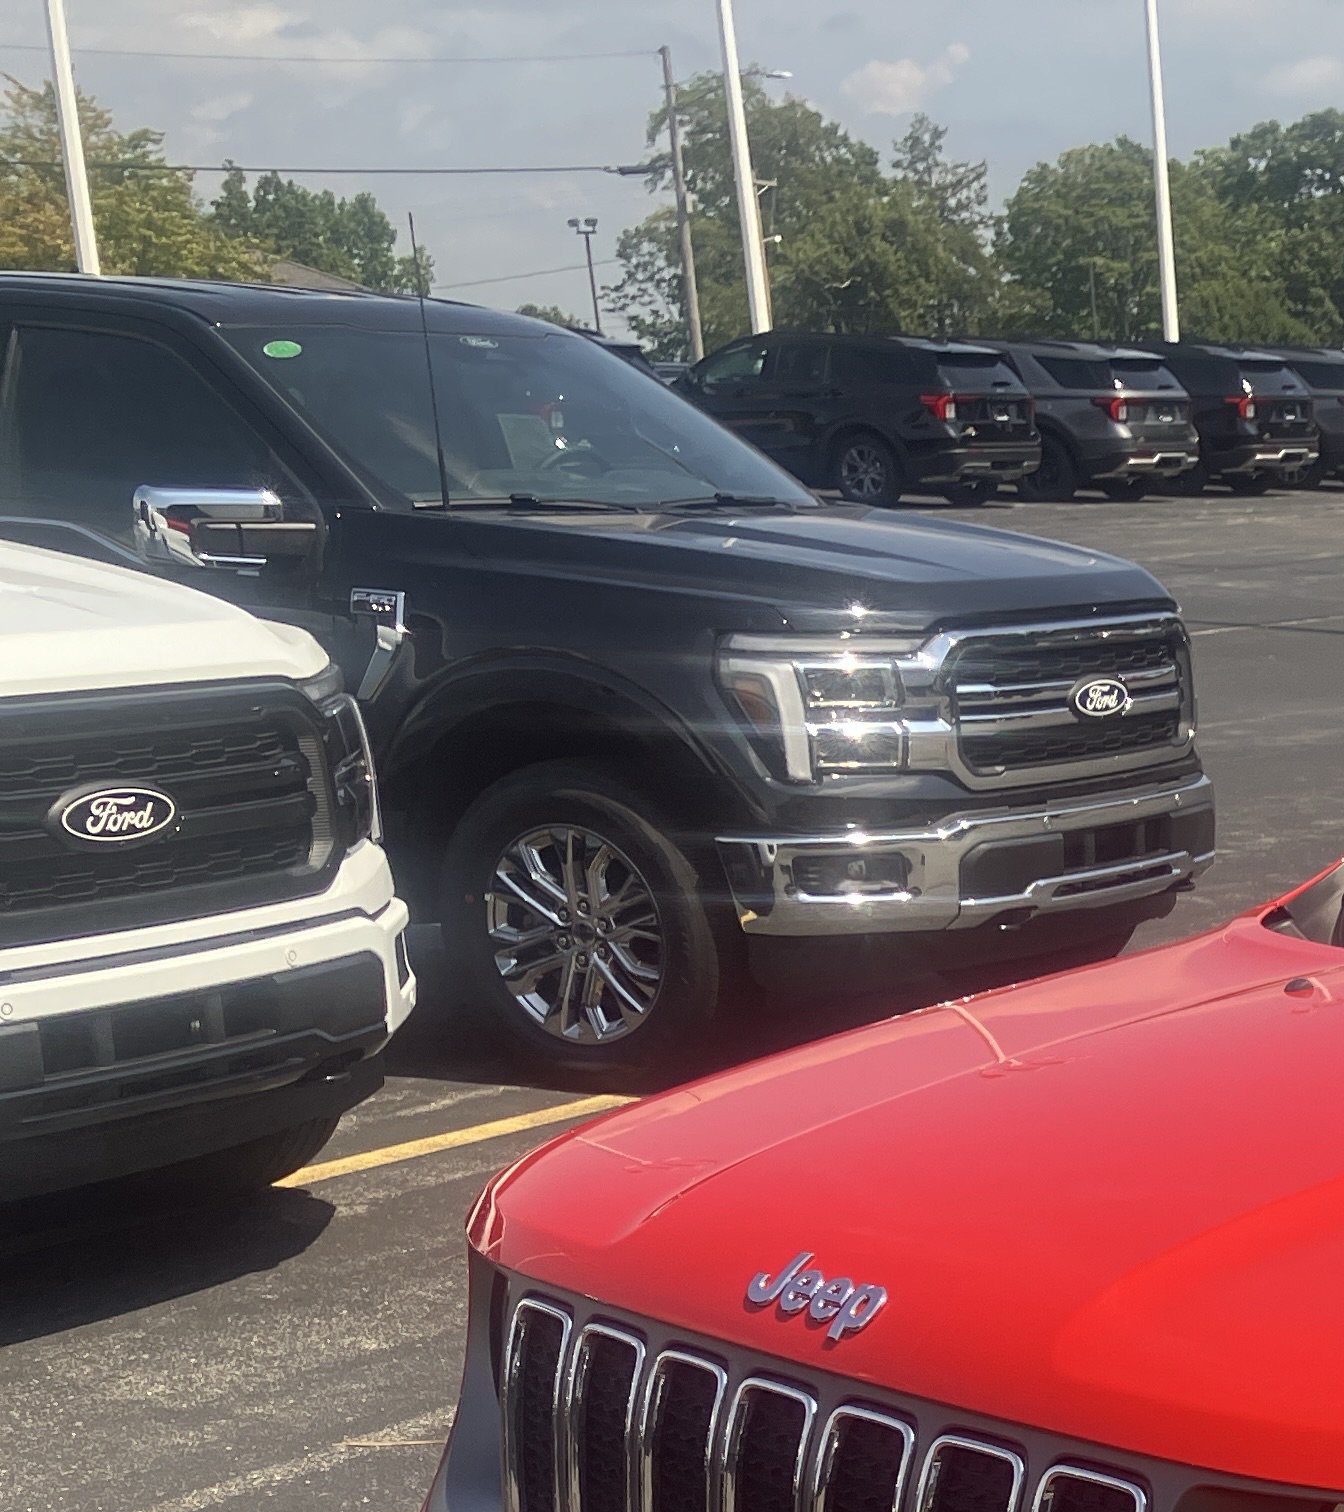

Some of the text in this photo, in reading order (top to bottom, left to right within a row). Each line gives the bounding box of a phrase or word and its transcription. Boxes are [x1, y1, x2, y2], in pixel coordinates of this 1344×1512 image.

[1086, 685, 1118, 710] Ford
[86, 796, 154, 834] Ford
[747, 1252, 888, 1340] Jeep
